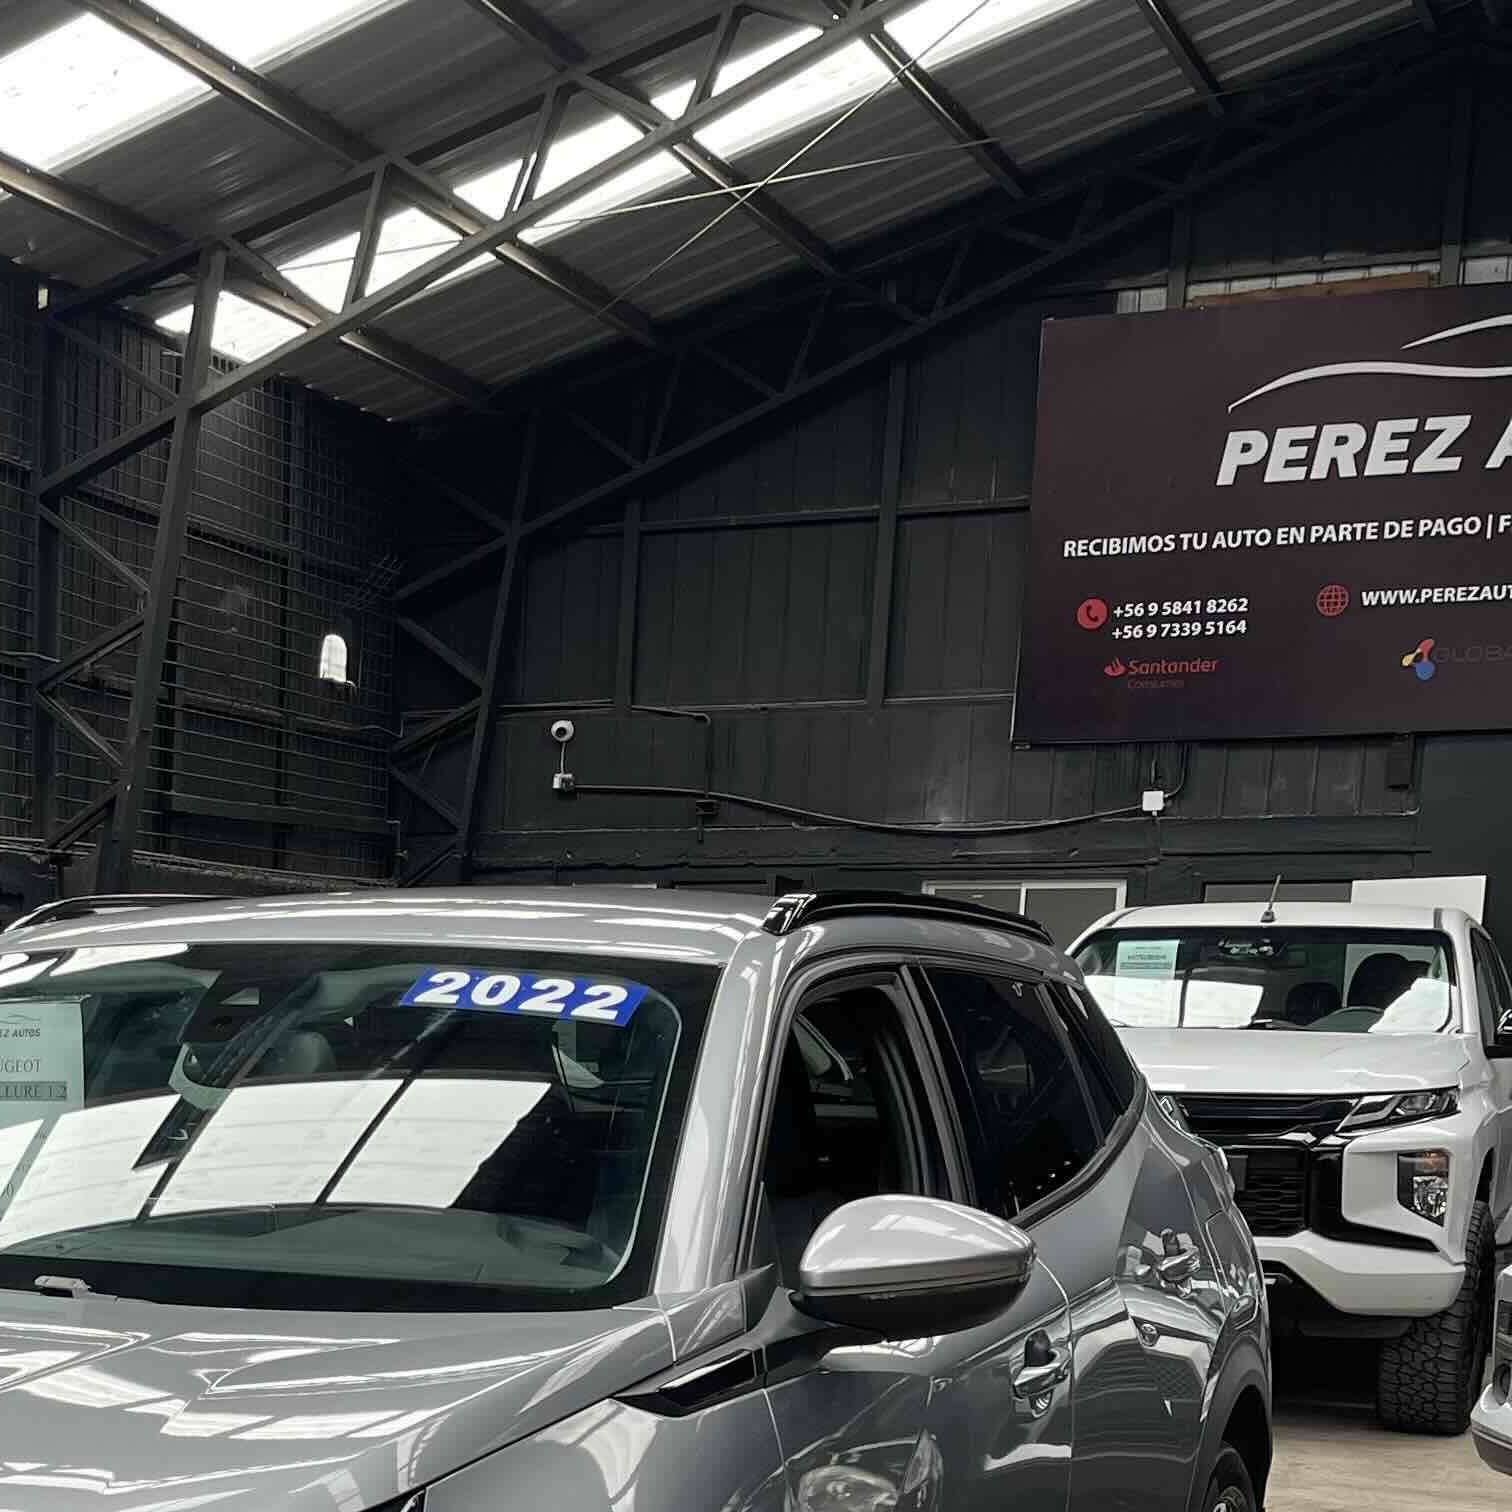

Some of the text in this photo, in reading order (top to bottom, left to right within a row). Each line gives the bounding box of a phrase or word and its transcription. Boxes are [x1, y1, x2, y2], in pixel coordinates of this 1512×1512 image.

[1215, 414, 1473, 487] PEREZ
[1063, 533, 1176, 558] RECIBIMOS
[1180, 531, 1208, 550] TU
[1211, 527, 1272, 549] AUTO
[1276, 526, 1305, 546] EN
[1309, 521, 1380, 543] PARTE
[1383, 519, 1414, 539] DE
[1418, 515, 1482, 537] PAGO
[1113, 598, 1249, 618] +56 9 5841 8262
[1112, 620, 1247, 639] +56 9 7339 5164
[1128, 658, 1218, 675] Santander
[414, 971, 628, 1021] 2022
[12, 1027, 40, 1038] AUTOS
